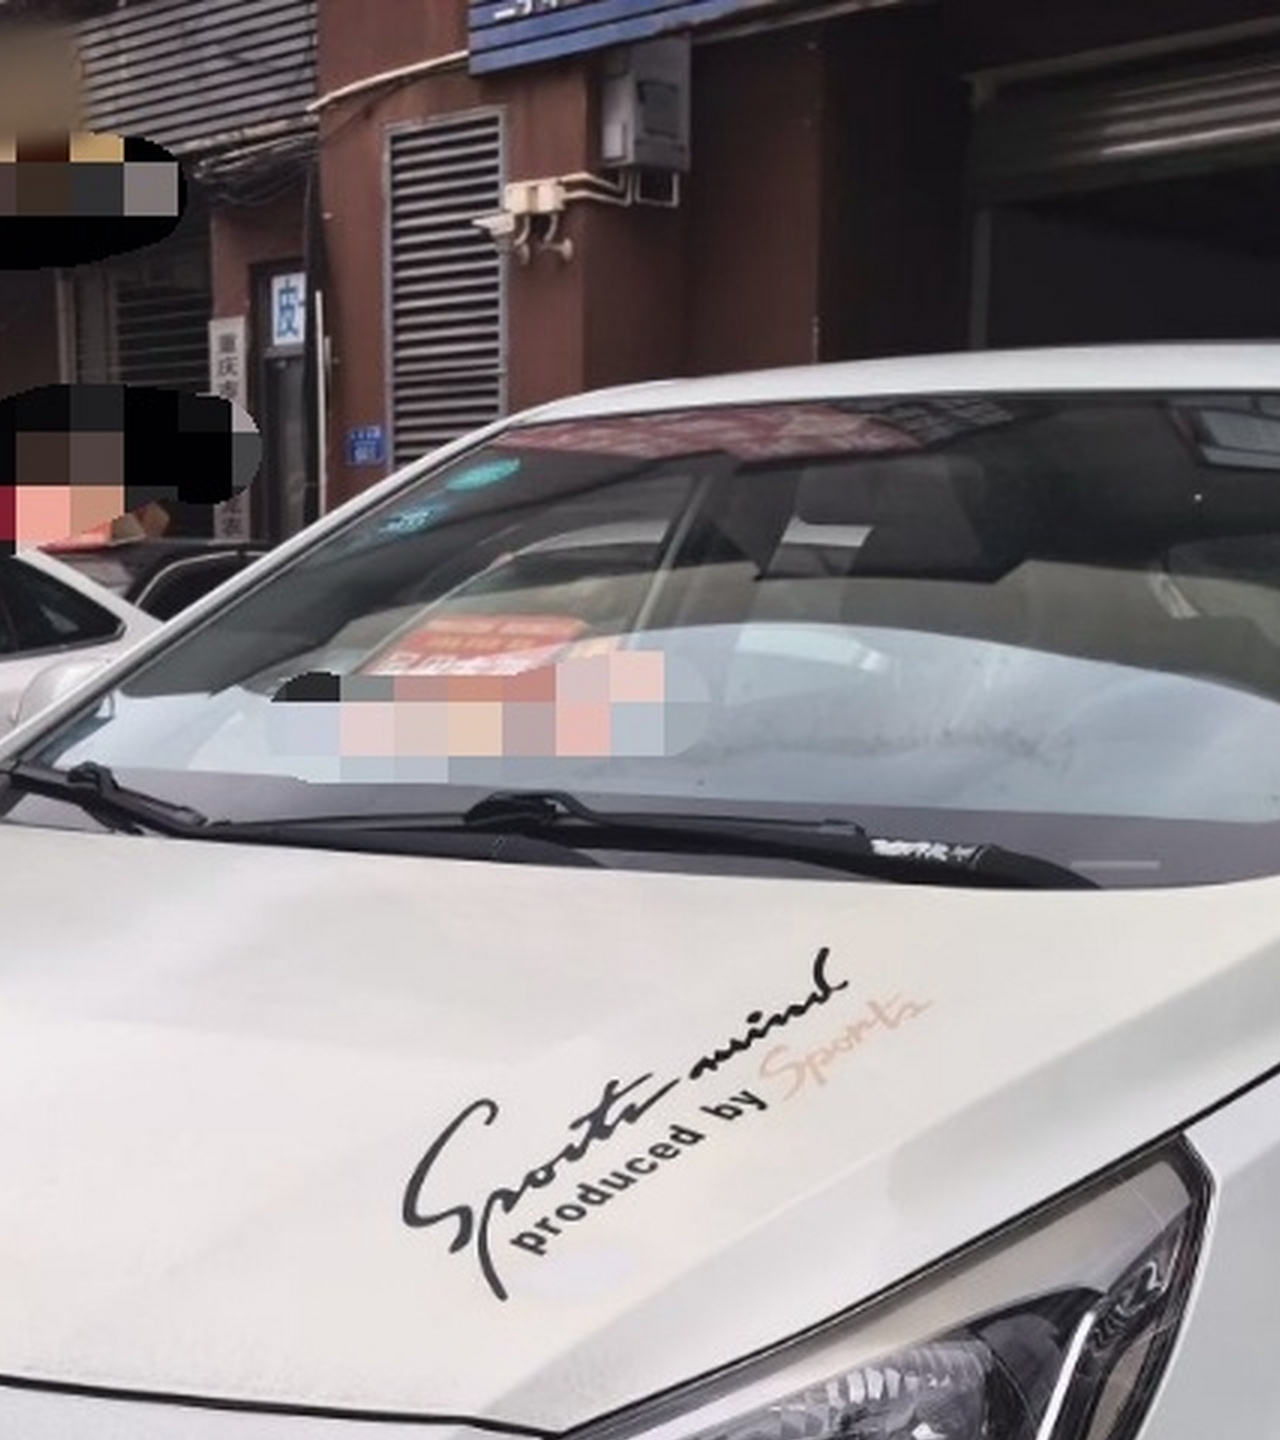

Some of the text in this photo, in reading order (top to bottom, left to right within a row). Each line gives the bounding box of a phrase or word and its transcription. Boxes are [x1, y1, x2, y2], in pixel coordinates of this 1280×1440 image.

[509, 993, 935, 1256] produced by Sports
